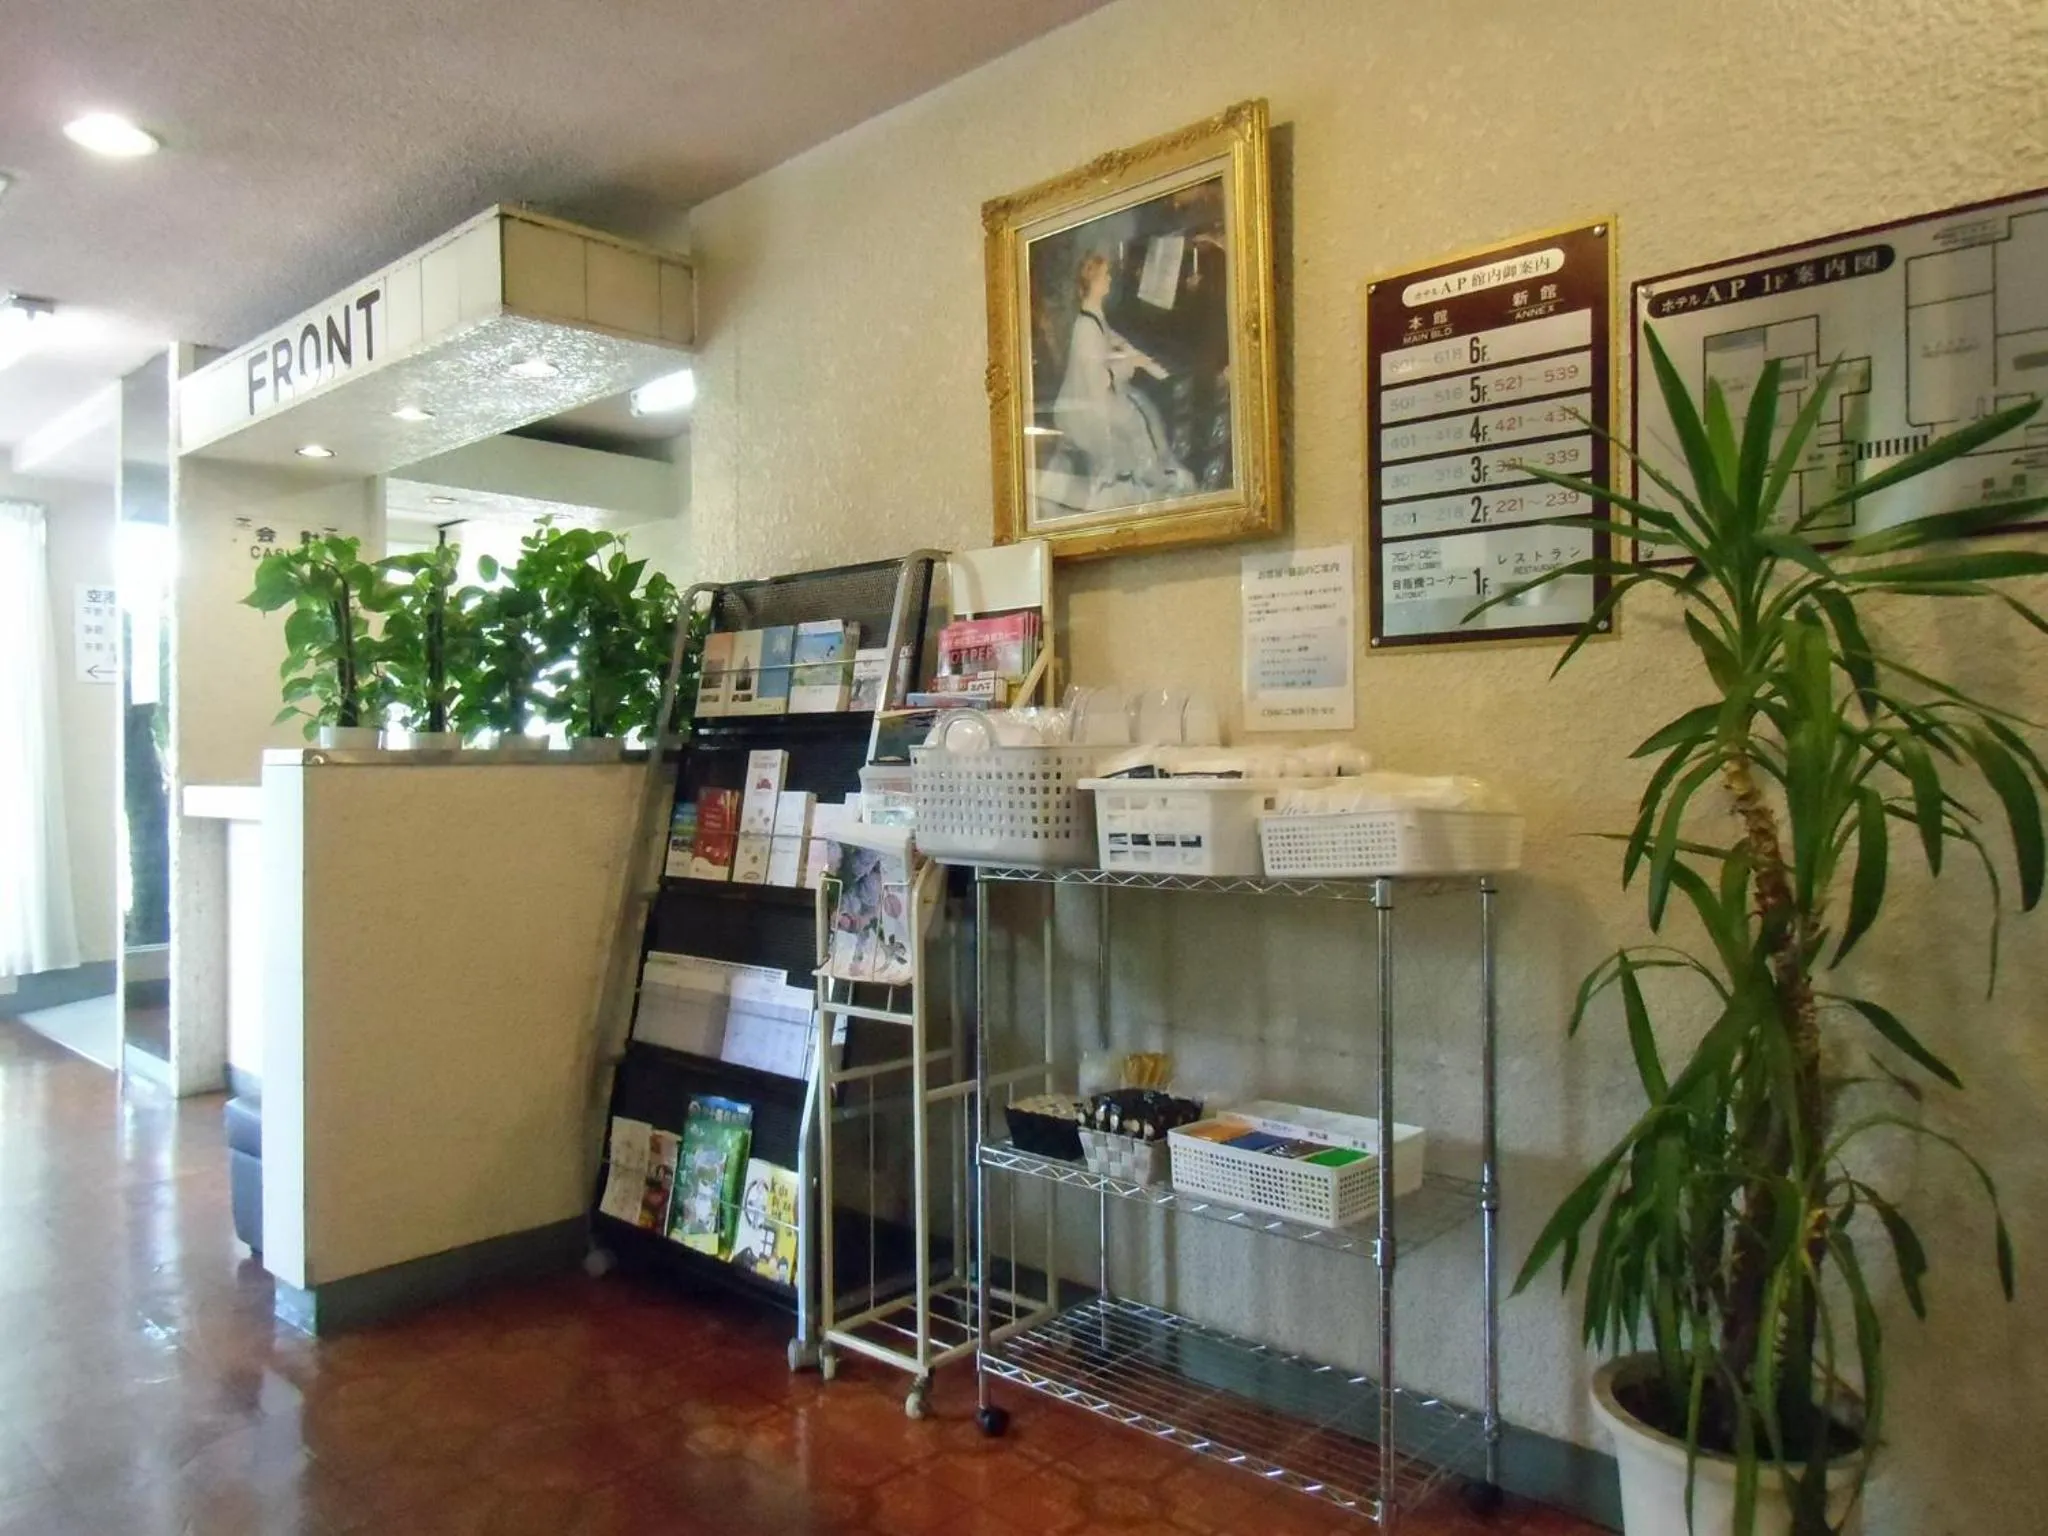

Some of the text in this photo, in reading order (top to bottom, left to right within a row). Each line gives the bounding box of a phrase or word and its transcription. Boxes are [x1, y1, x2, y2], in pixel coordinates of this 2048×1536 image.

[1514, 304, 1556, 321] ANNEX
[1402, 331, 1429, 345] MAIN
[247, 288, 381, 417] FRONT
[1497, 546, 1581, 566] レストラン
